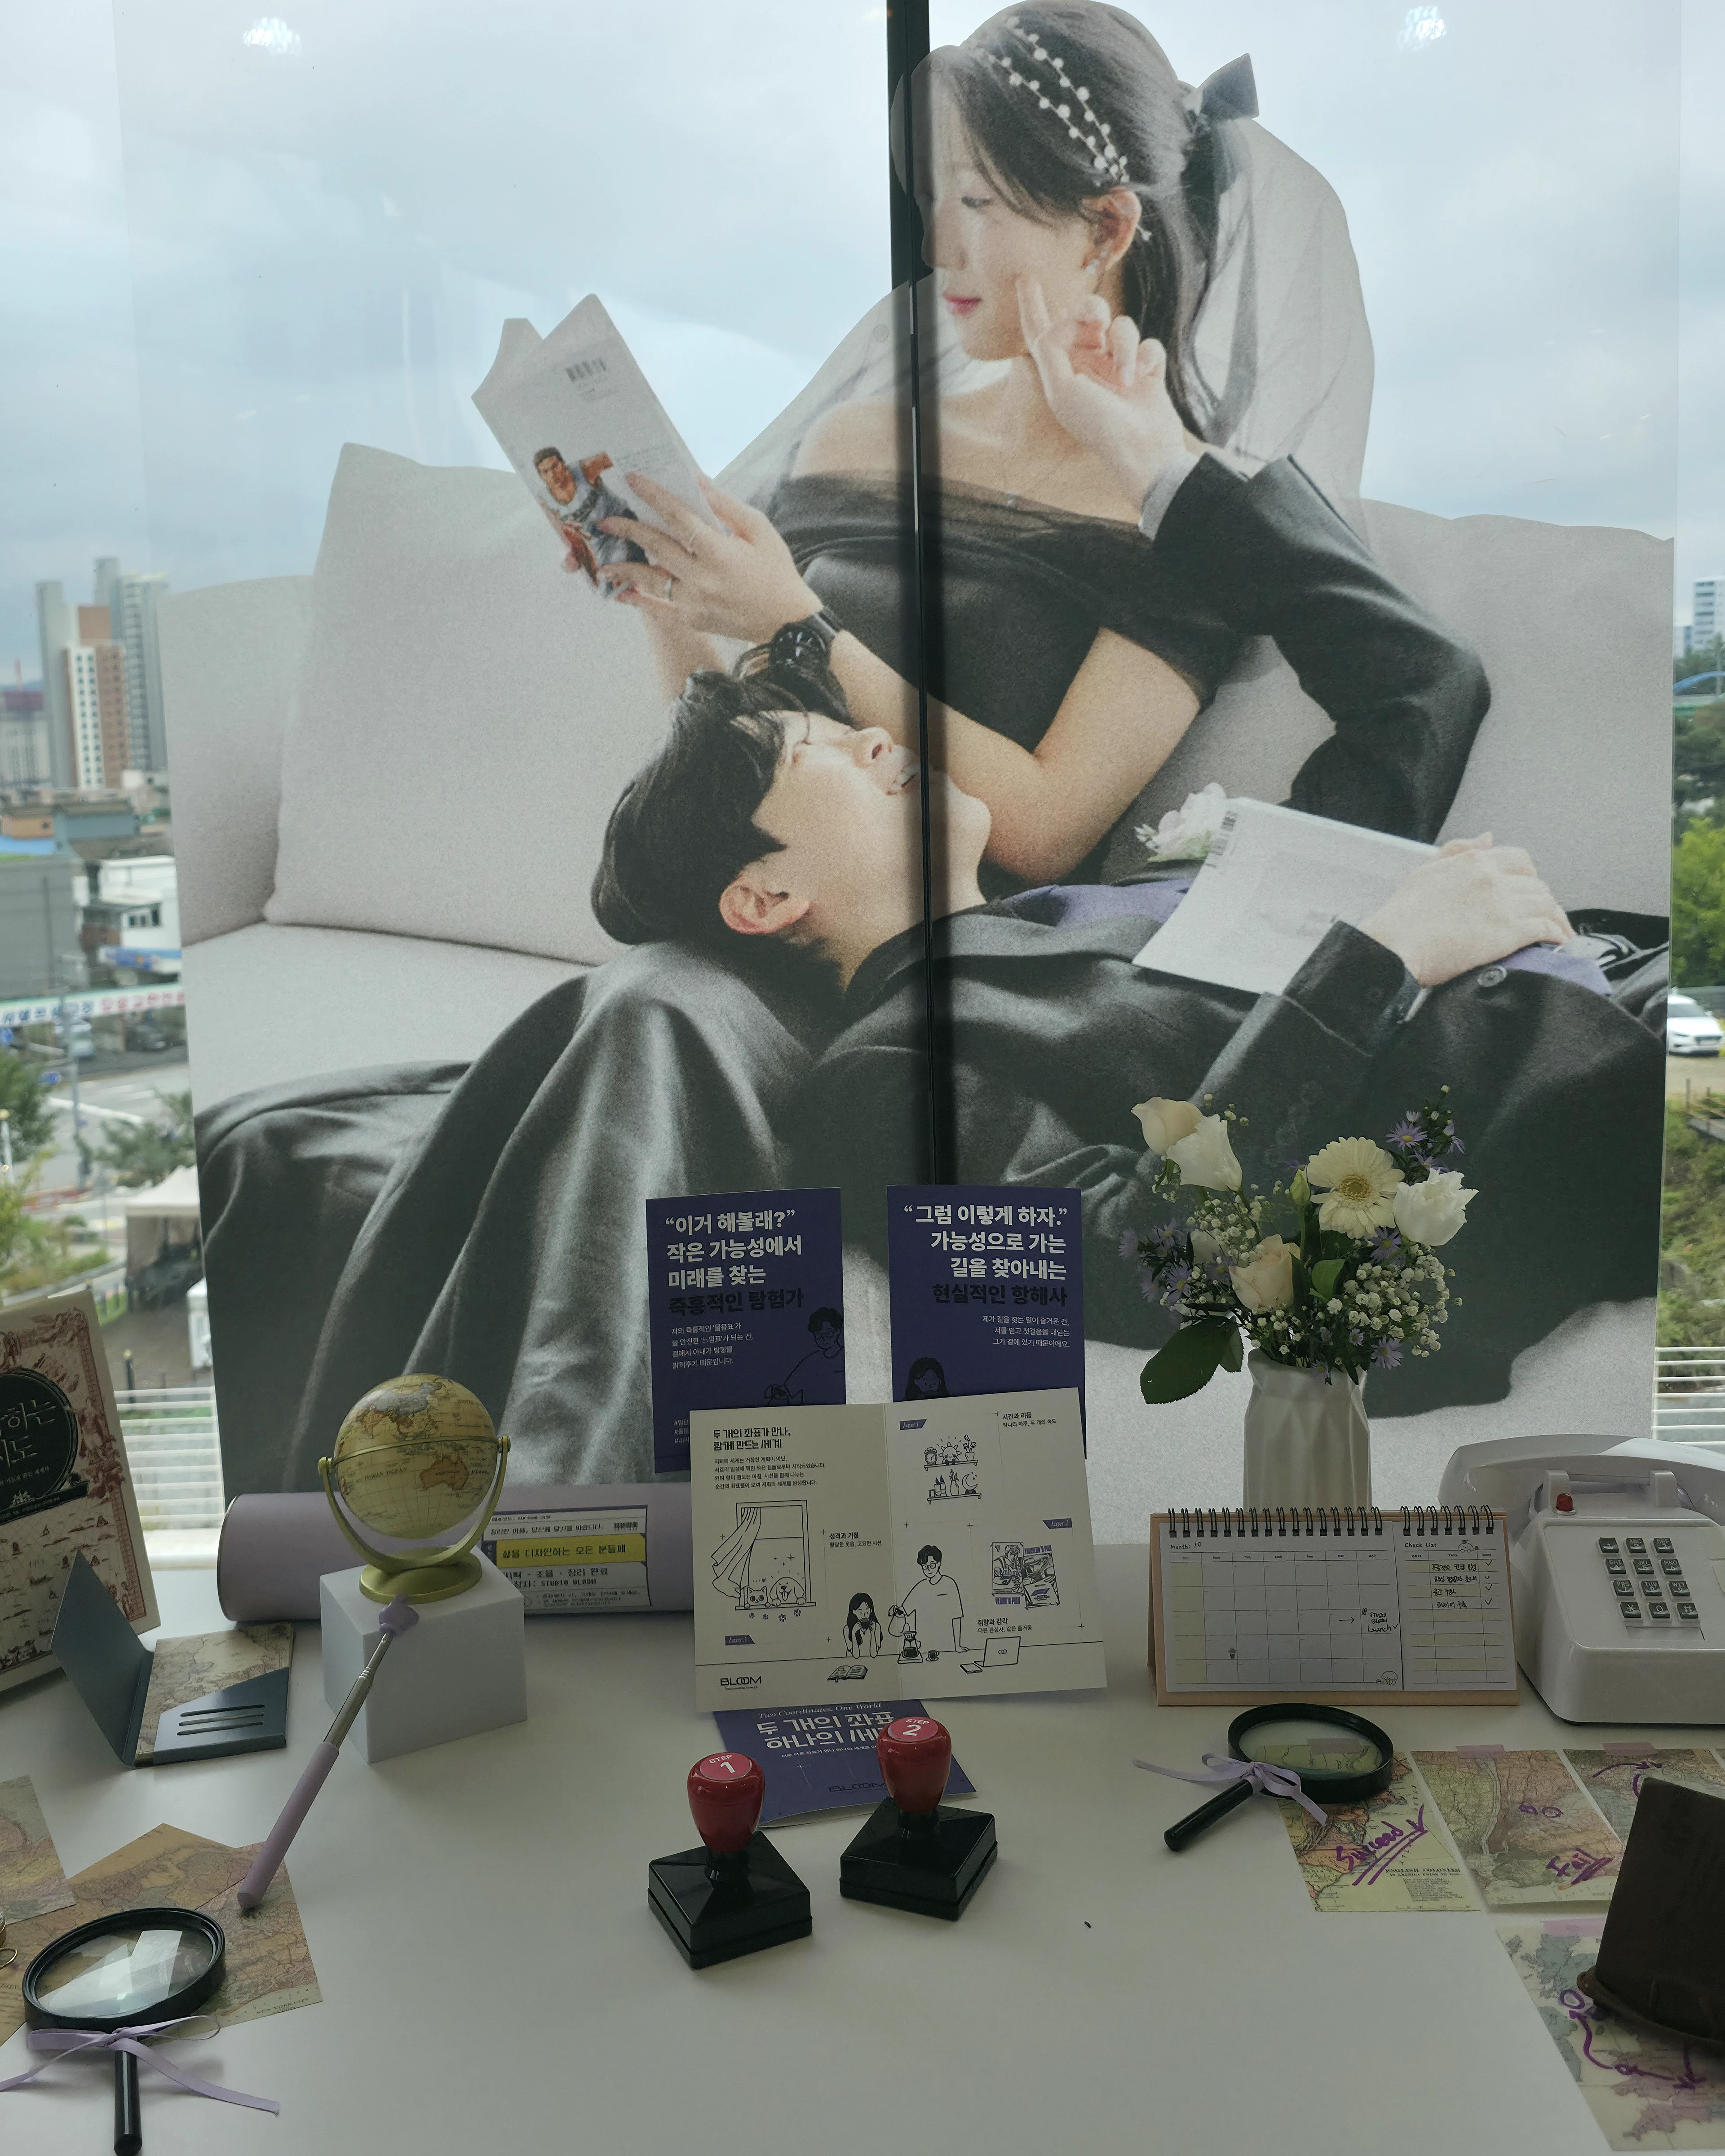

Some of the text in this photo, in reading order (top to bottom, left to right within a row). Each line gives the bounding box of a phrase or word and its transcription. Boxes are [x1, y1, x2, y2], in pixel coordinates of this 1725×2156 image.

[665, 1209, 796, 1235] “이거 해볼래?”
[957, 1205, 1013, 1226] 이렇게
[1017, 1206, 1067, 1227] 하자.”
[667, 1235, 801, 1263] 작은 가능성에서
[931, 1231, 1066, 1254] 가능성으로 가는
[950, 1257, 1067, 1280] 길을 찾아내는
[668, 1264, 766, 1290] 미래를 찾는
[668, 1288, 804, 1316] 즉흥적인 탐험가
[932, 1283, 1067, 1307] 현실적인 항해사
[1040, 1317, 1059, 1325] 즐거운
[713, 1427, 791, 1439] 두 개의 좌표가 만나,
[714, 1438, 782, 1451] 함께 만드는 세계
[525, 1546, 570, 1557] 디자인하는
[576, 1545, 593, 1555] 모든
[1436, 1601, 1455, 1609] 레이어
[1367, 1624, 1392, 1633] Launch
[720, 1676, 762, 1686] BLOOM
[856, 1701, 881, 1710] World
[757, 1722, 779, 1735] 두
[783, 1715, 842, 1732] 개의
[902, 1724, 921, 1736] 2
[764, 1730, 844, 1750] 하나의
[709, 1754, 733, 1765] STEP
[720, 1760, 736, 1774] 1
